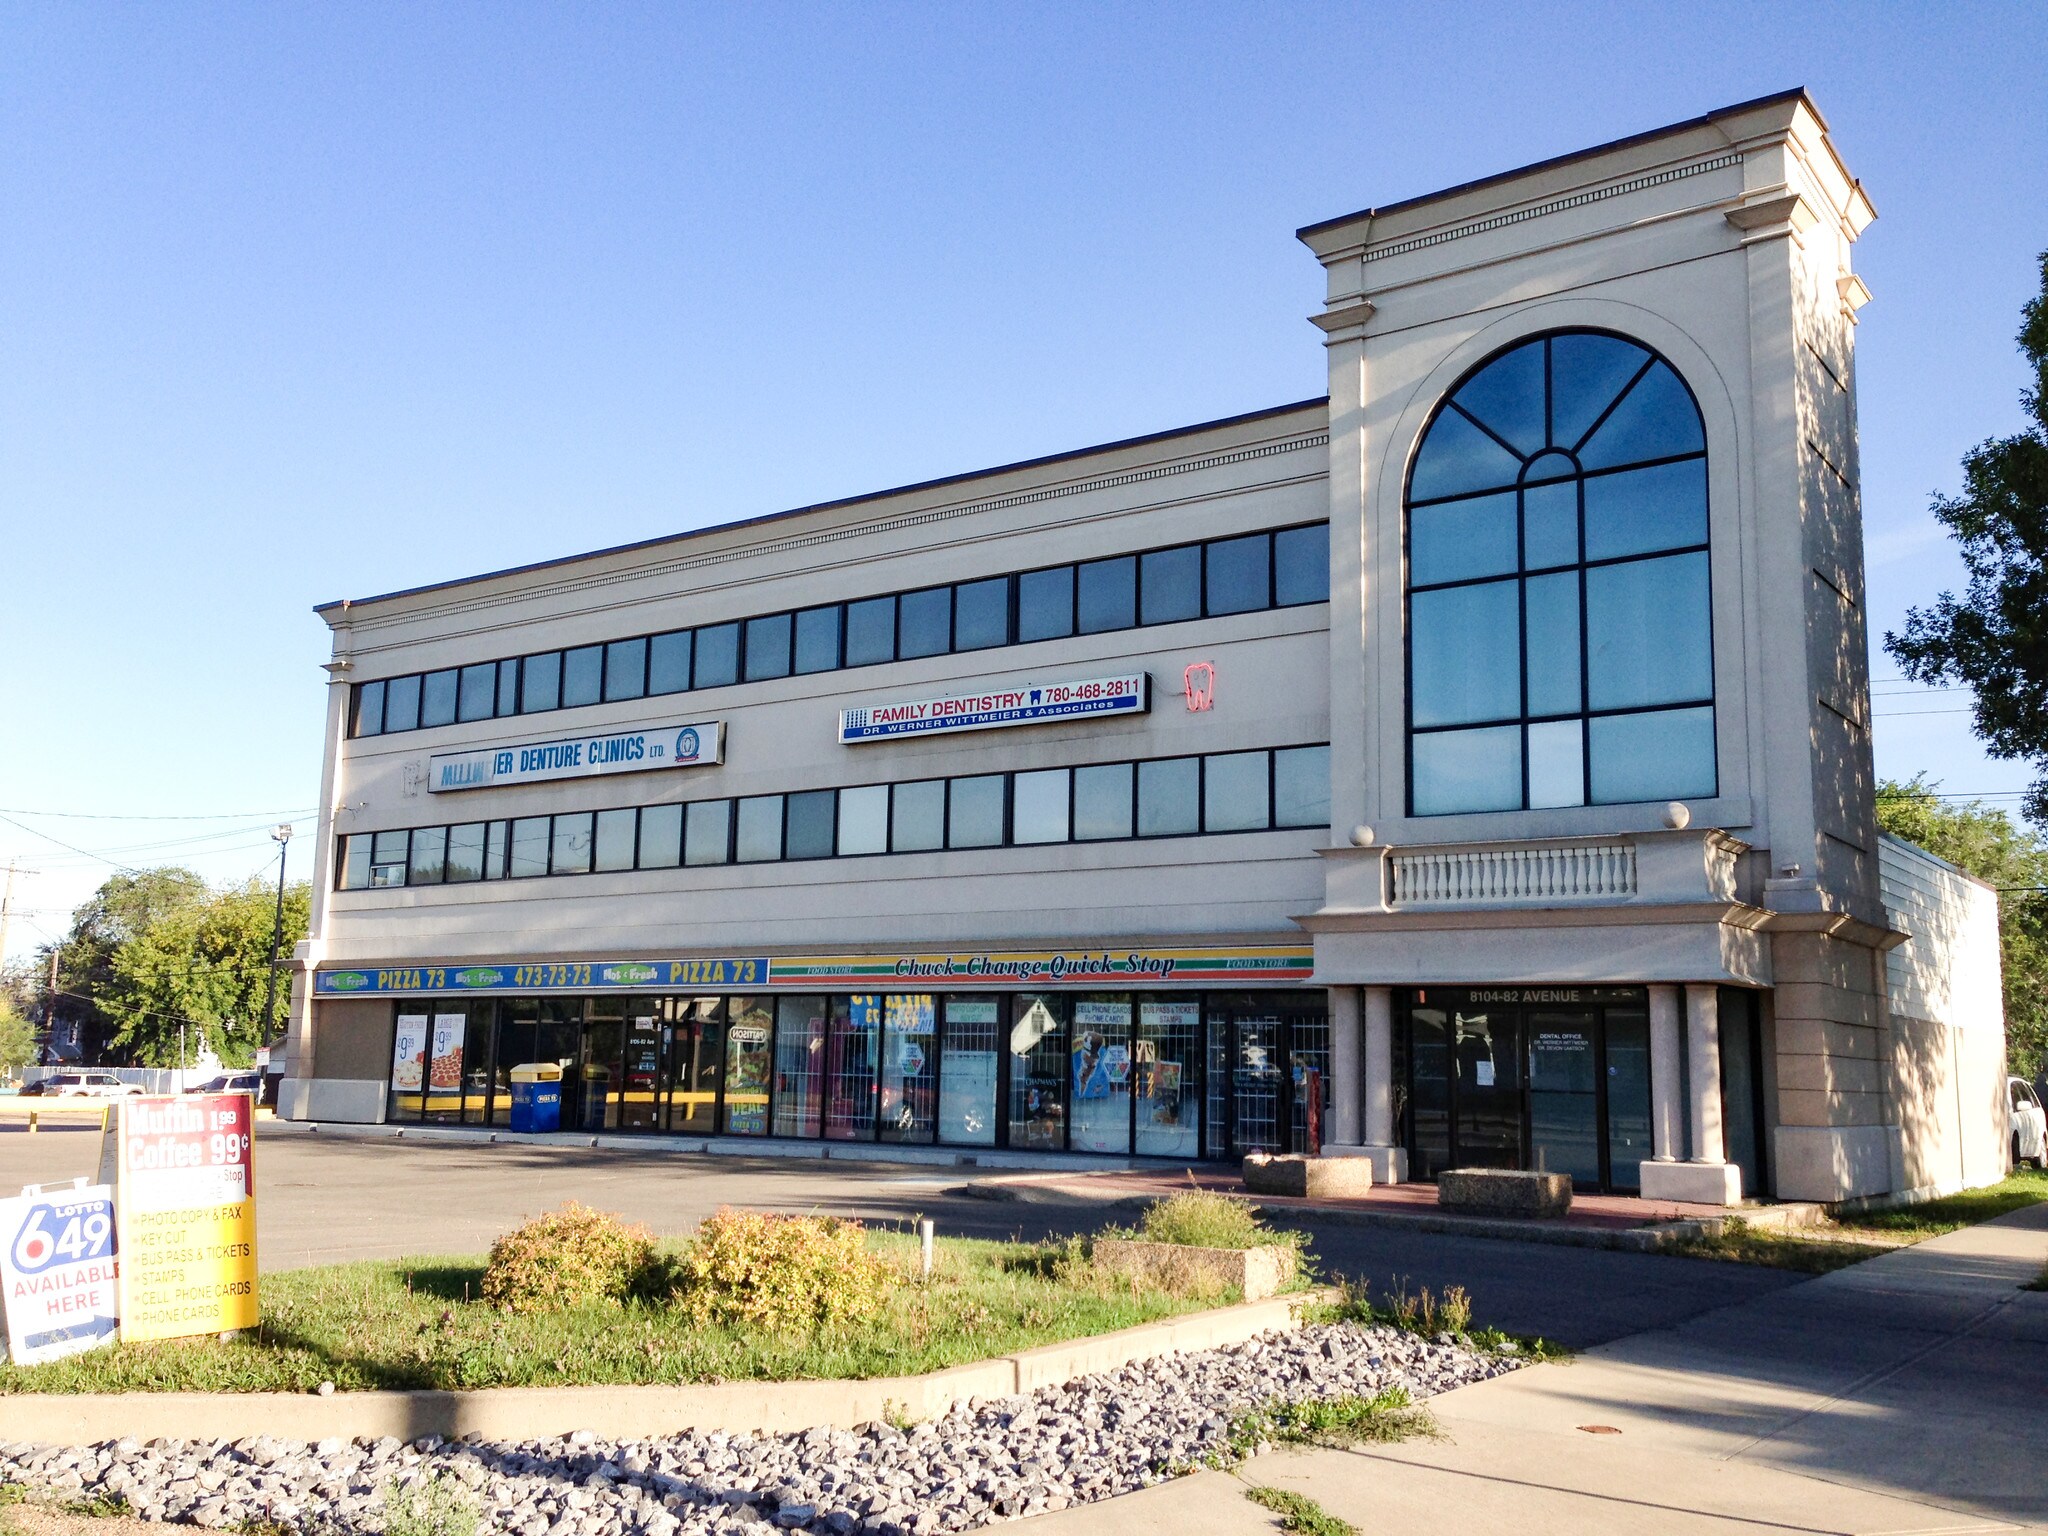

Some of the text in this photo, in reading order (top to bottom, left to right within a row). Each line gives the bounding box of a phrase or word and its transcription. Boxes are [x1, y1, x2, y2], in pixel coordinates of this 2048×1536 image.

[873, 679, 1139, 724] FAMILY DENTISTRY 780-468-2811
[863, 701, 1115, 736] DR. WERNER WITTMEIER & Associates
[520, 743, 582, 772] DENTURE
[588, 735, 645, 765] CLINICS
[629, 967, 658, 980] Fresh
[670, 961, 757, 984] PIZZA 73
[807, 966, 854, 975] FOOD STORE
[894, 953, 1176, 979] Chuck Change Quick Stop
[1226, 957, 1291, 969] FOOD STORE
[377, 969, 446, 989] PIZZA 73
[514, 965, 592, 986] 473-73-73
[1470, 990, 1580, 1003] 8104-82 AVENUE
[127, 1101, 205, 1136] Muffin
[127, 1136, 203, 1169] Coffee
[223, 1168, 243, 1184] Stop
[55, 1201, 104, 1219] LOTTO
[141, 1205, 242, 1227] PHOTO COPY & FAX
[141, 1229, 187, 1246] KEY CUT
[141, 1242, 250, 1266] BUS PASS & TICKETS
[141, 1269, 185, 1286] STAMPS
[46, 1289, 100, 1317] HERE
[142, 1280, 251, 1306] CELL PHONE CARDS
[142, 1303, 220, 1325] PHONE CARDS
